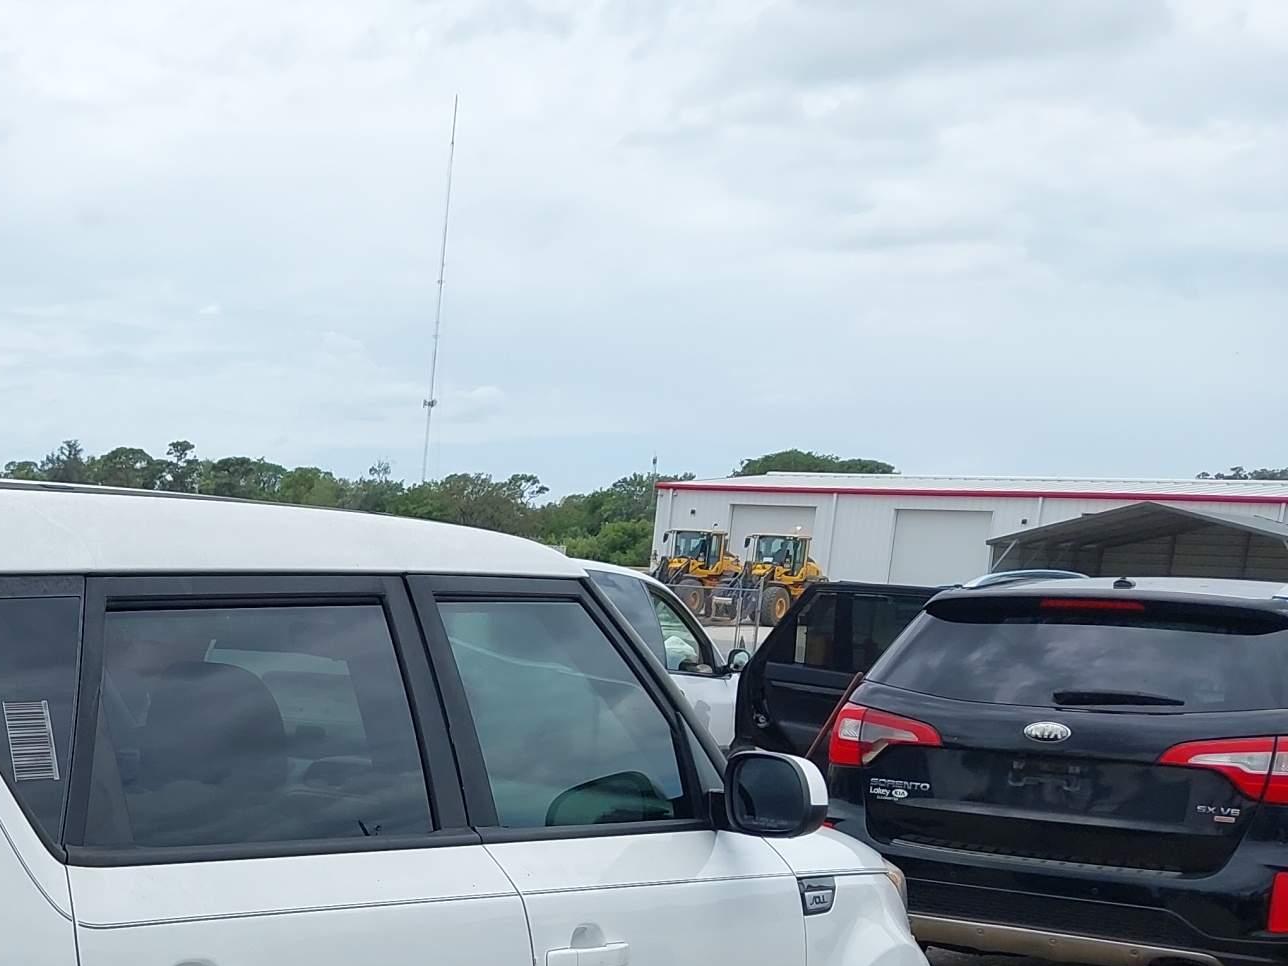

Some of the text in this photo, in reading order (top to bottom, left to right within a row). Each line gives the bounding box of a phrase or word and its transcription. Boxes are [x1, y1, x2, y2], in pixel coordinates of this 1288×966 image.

[1028, 723, 1065, 739] KIA
[870, 777, 931, 791] SORENTO
[1197, 805, 1217, 814] SX
